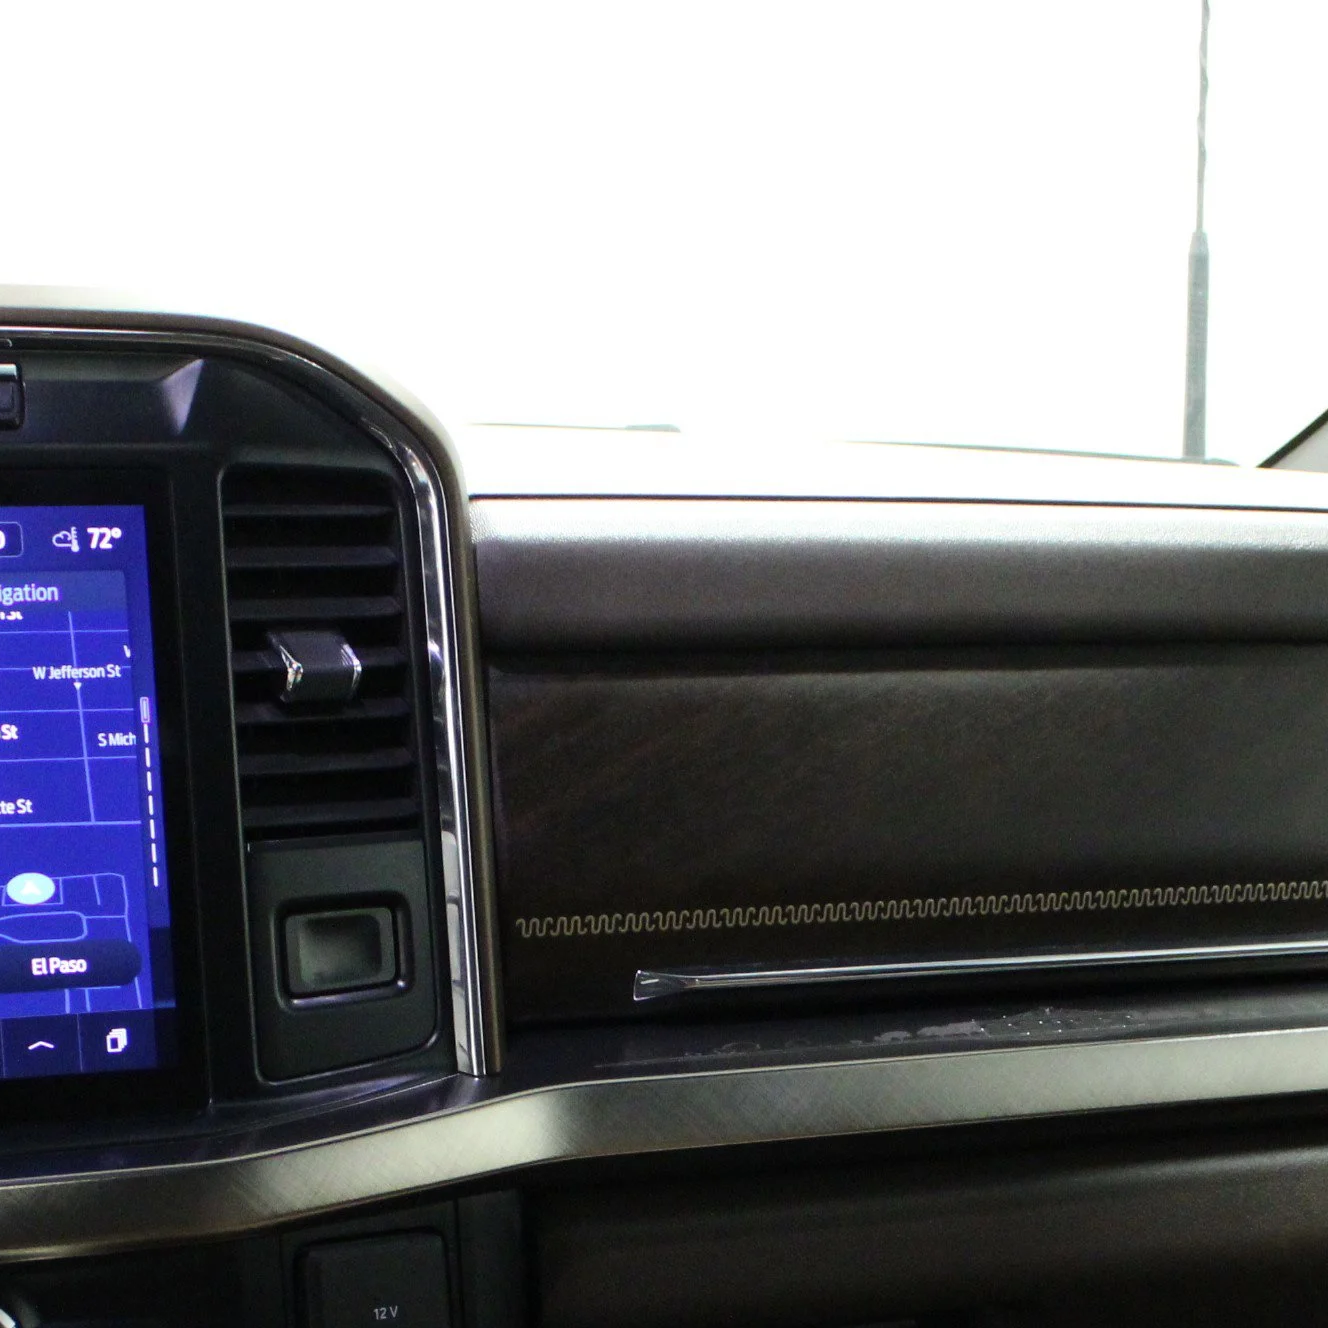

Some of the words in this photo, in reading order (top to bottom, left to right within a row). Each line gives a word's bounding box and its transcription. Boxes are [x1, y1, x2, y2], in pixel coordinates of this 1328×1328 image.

[86, 526, 123, 550] 72°
[32, 666, 46, 680] W
[48, 664, 105, 680] Jefferson
[106, 663, 122, 678] St
[0, 723, 19, 740] St
[97, 732, 107, 747] S
[108, 731, 137, 747] Mich
[16, 798, 34, 815] St
[31, 957, 48, 976] El
[49, 956, 88, 975] Paso
